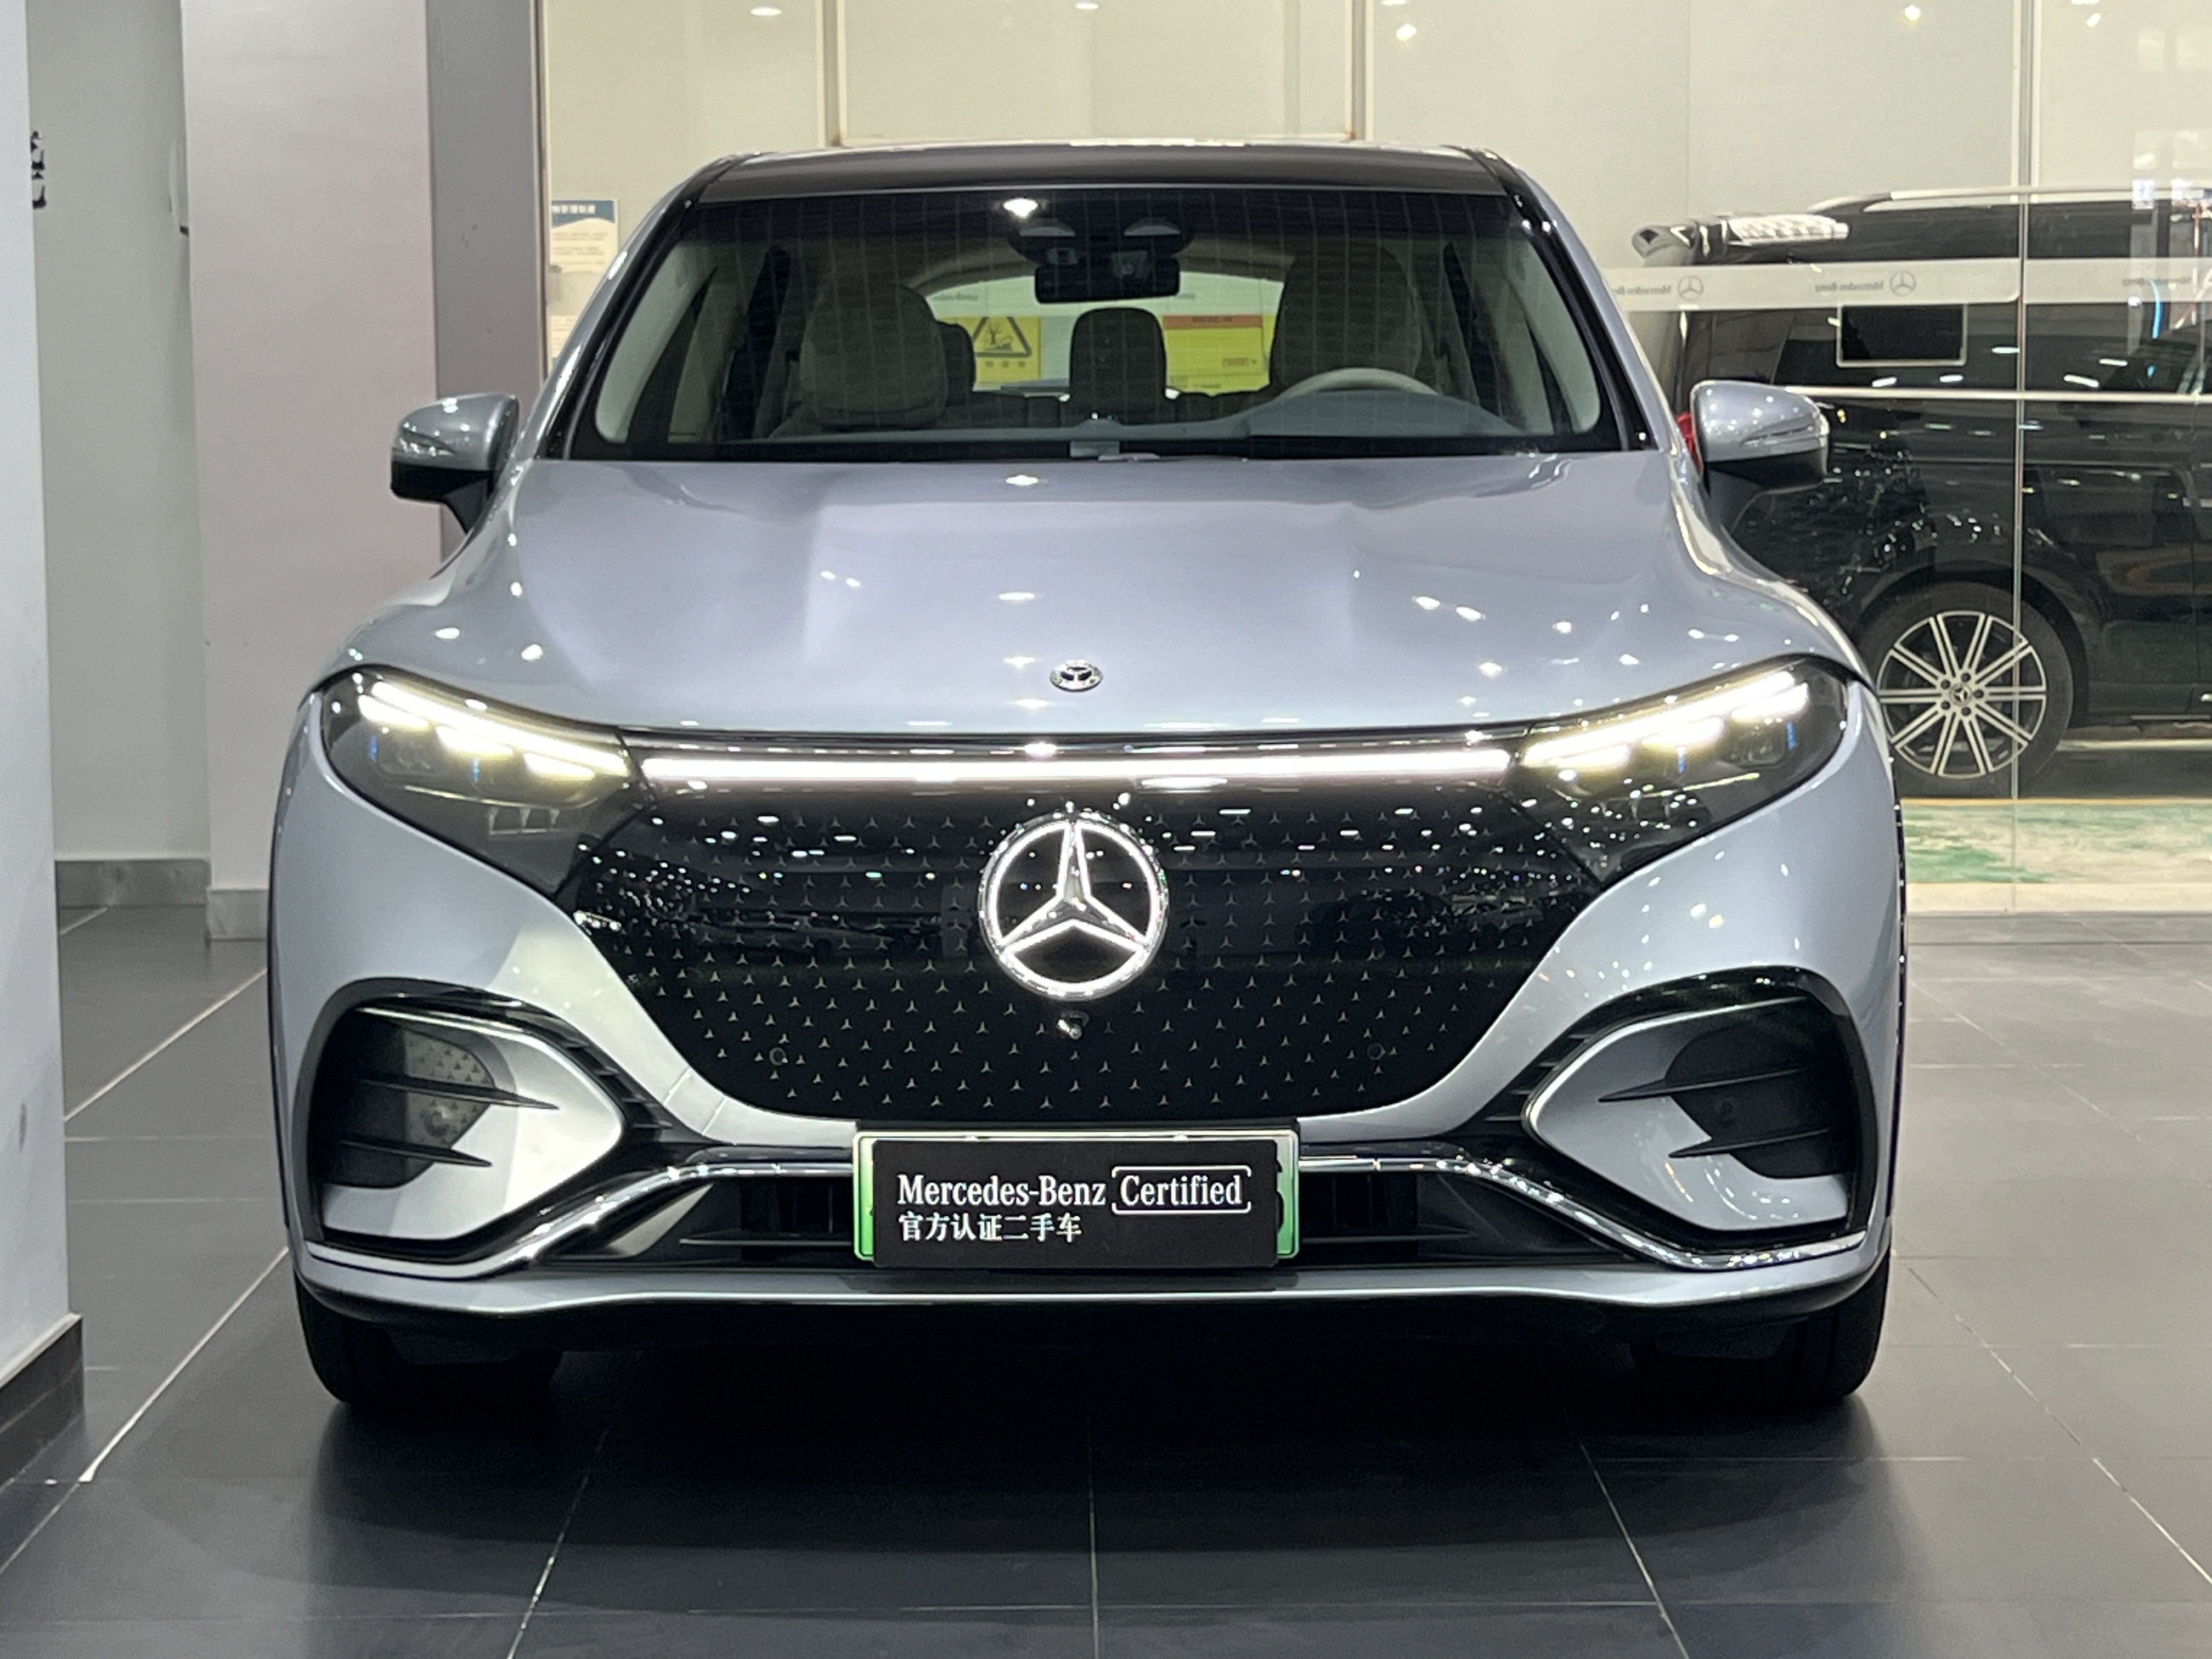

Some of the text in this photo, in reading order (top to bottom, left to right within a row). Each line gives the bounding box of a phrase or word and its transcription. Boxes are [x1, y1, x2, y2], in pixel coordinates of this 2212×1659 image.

[898, 1175, 1242, 1206] Mercedes-Benz Certified
[899, 1211, 1081, 1242] 官方认证二手车
